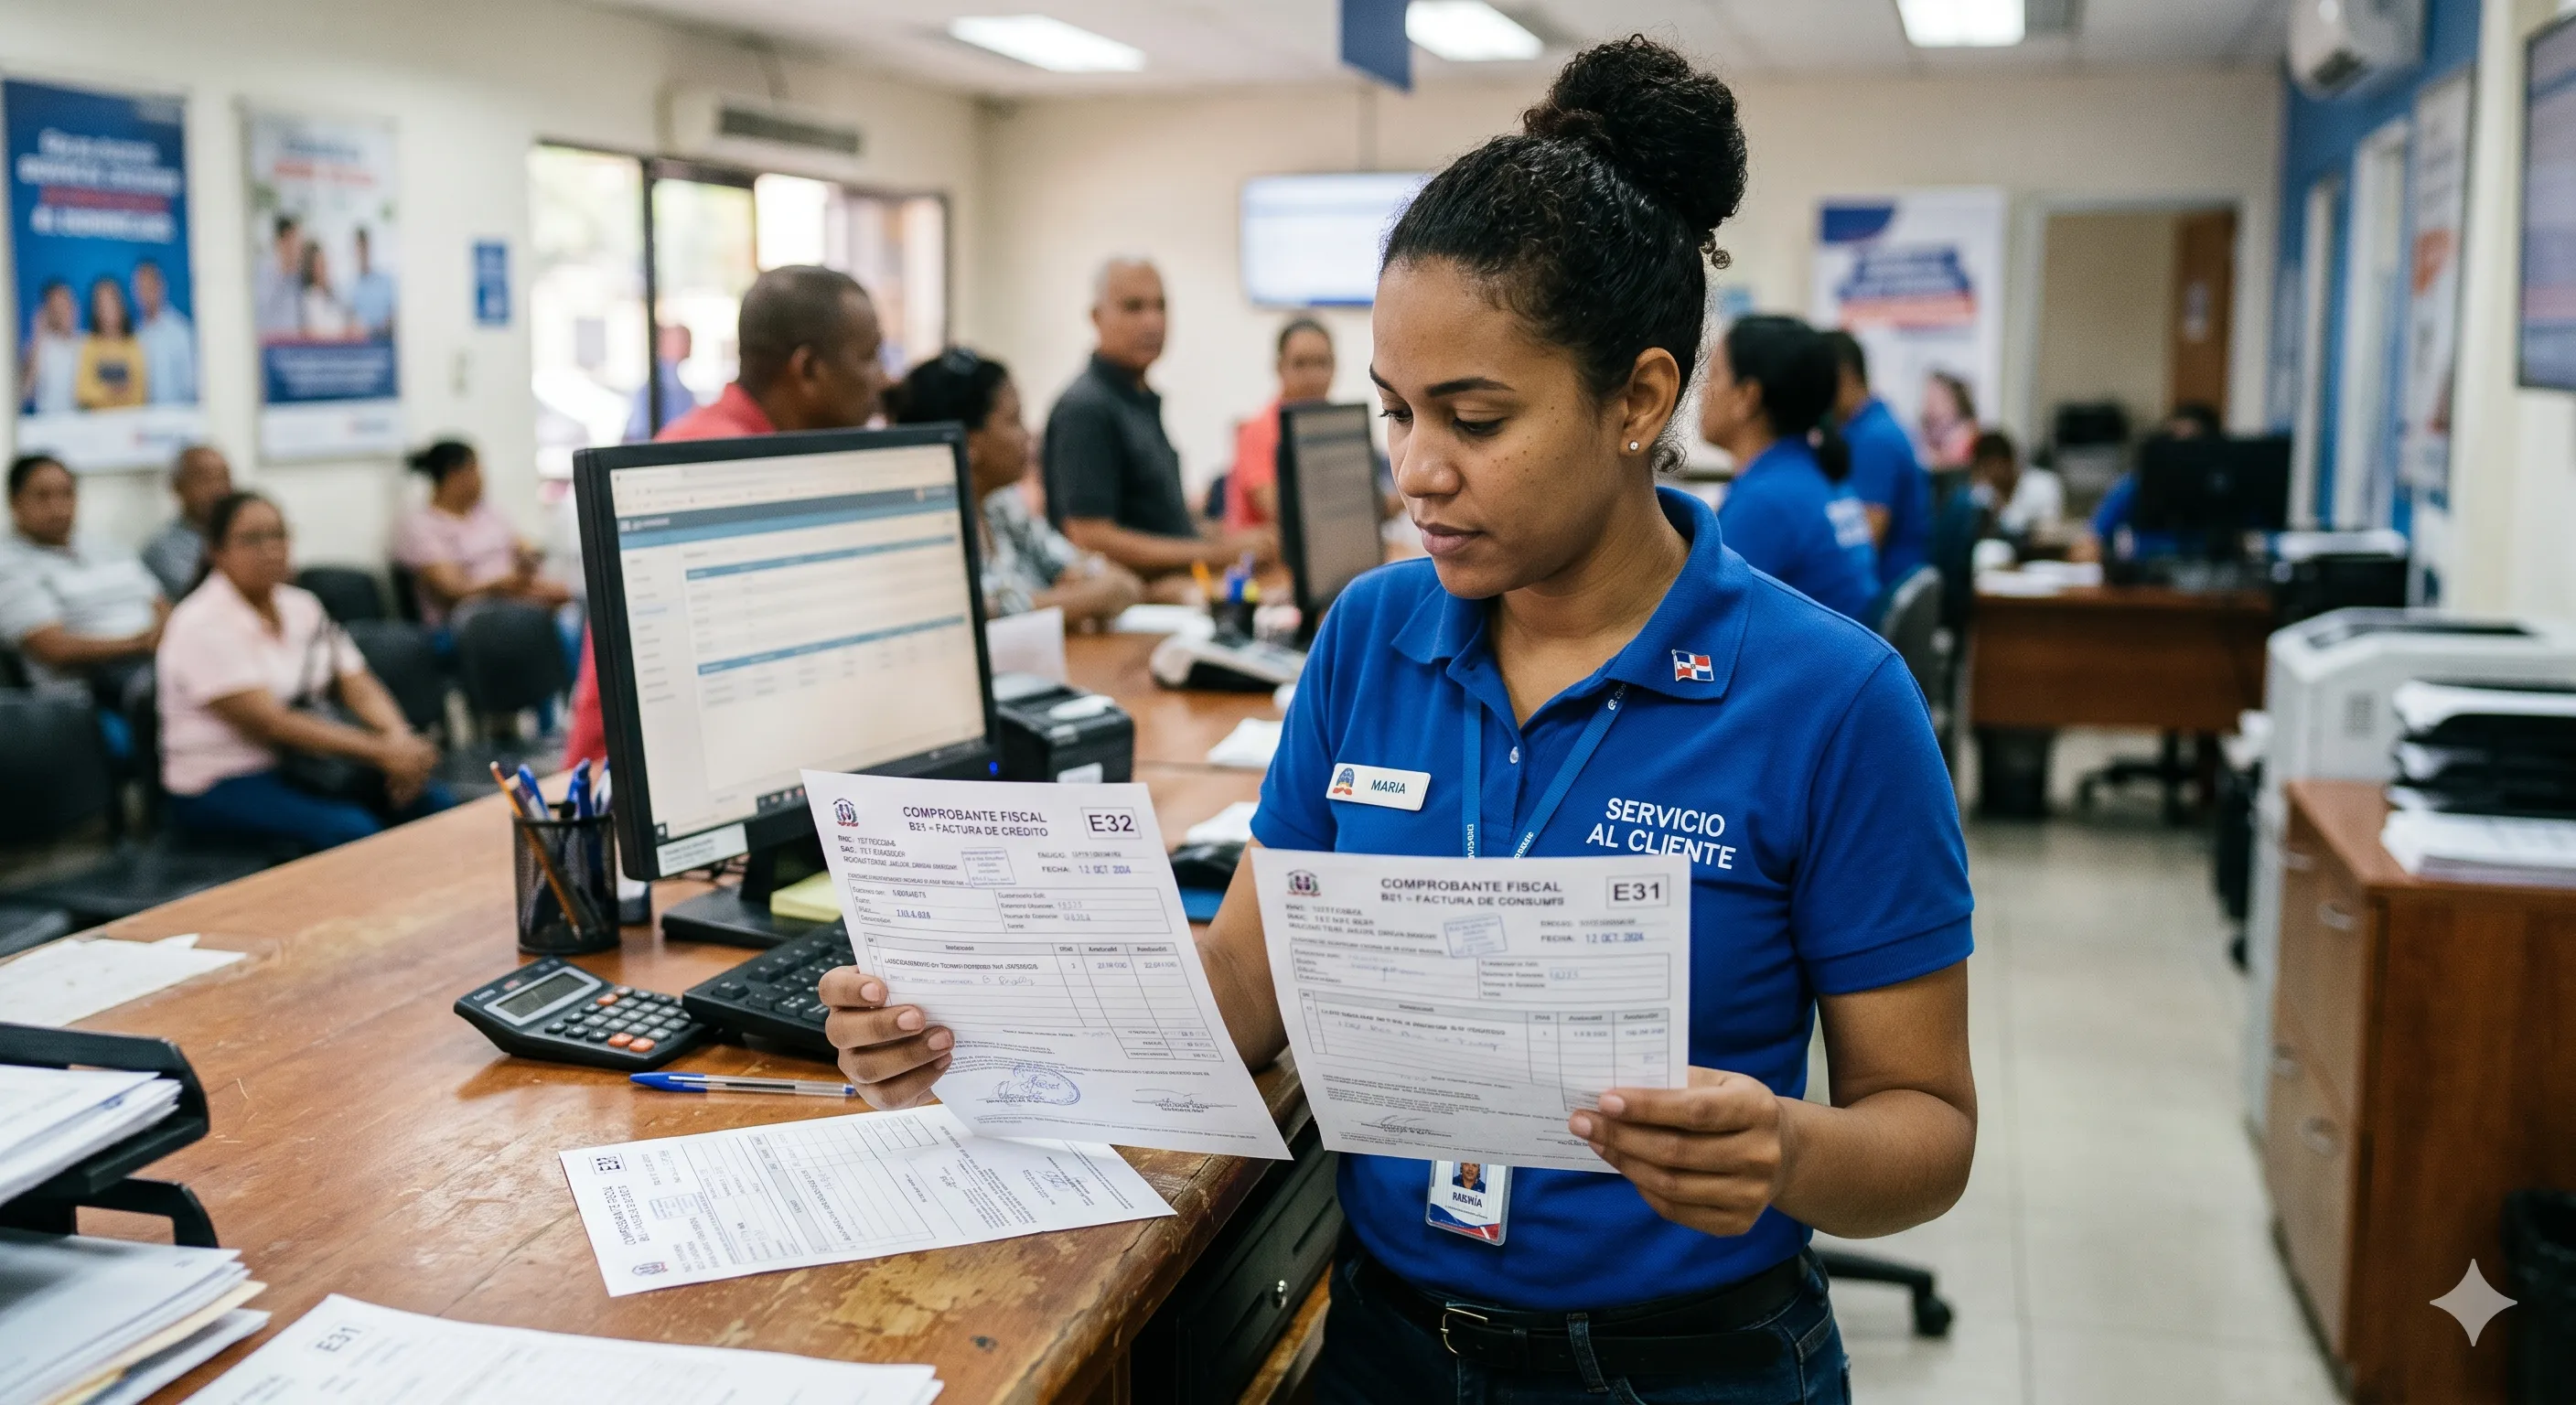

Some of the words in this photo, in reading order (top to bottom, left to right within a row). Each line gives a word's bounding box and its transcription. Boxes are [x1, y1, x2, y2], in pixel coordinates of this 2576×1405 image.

[1370, 779, 1406, 795] MARIA
[902, 806, 998, 822] COMPROBANTE
[1000, 811, 1048, 823] FISCAL
[1088, 814, 1135, 832] E32
[1605, 798, 1725, 838] SERVICIO
[936, 823, 982, 835] FACTURA
[984, 825, 999, 836] DE
[1585, 822, 1619, 849] AL
[1627, 829, 1737, 870] CLIENTE
[1380, 878, 1502, 893] COMPROBANTE
[1507, 881, 1562, 893] FISCAL
[1613, 883, 1661, 901] E31
[1416, 895, 1475, 906] FACTURA
[1477, 896, 1495, 906] DE
